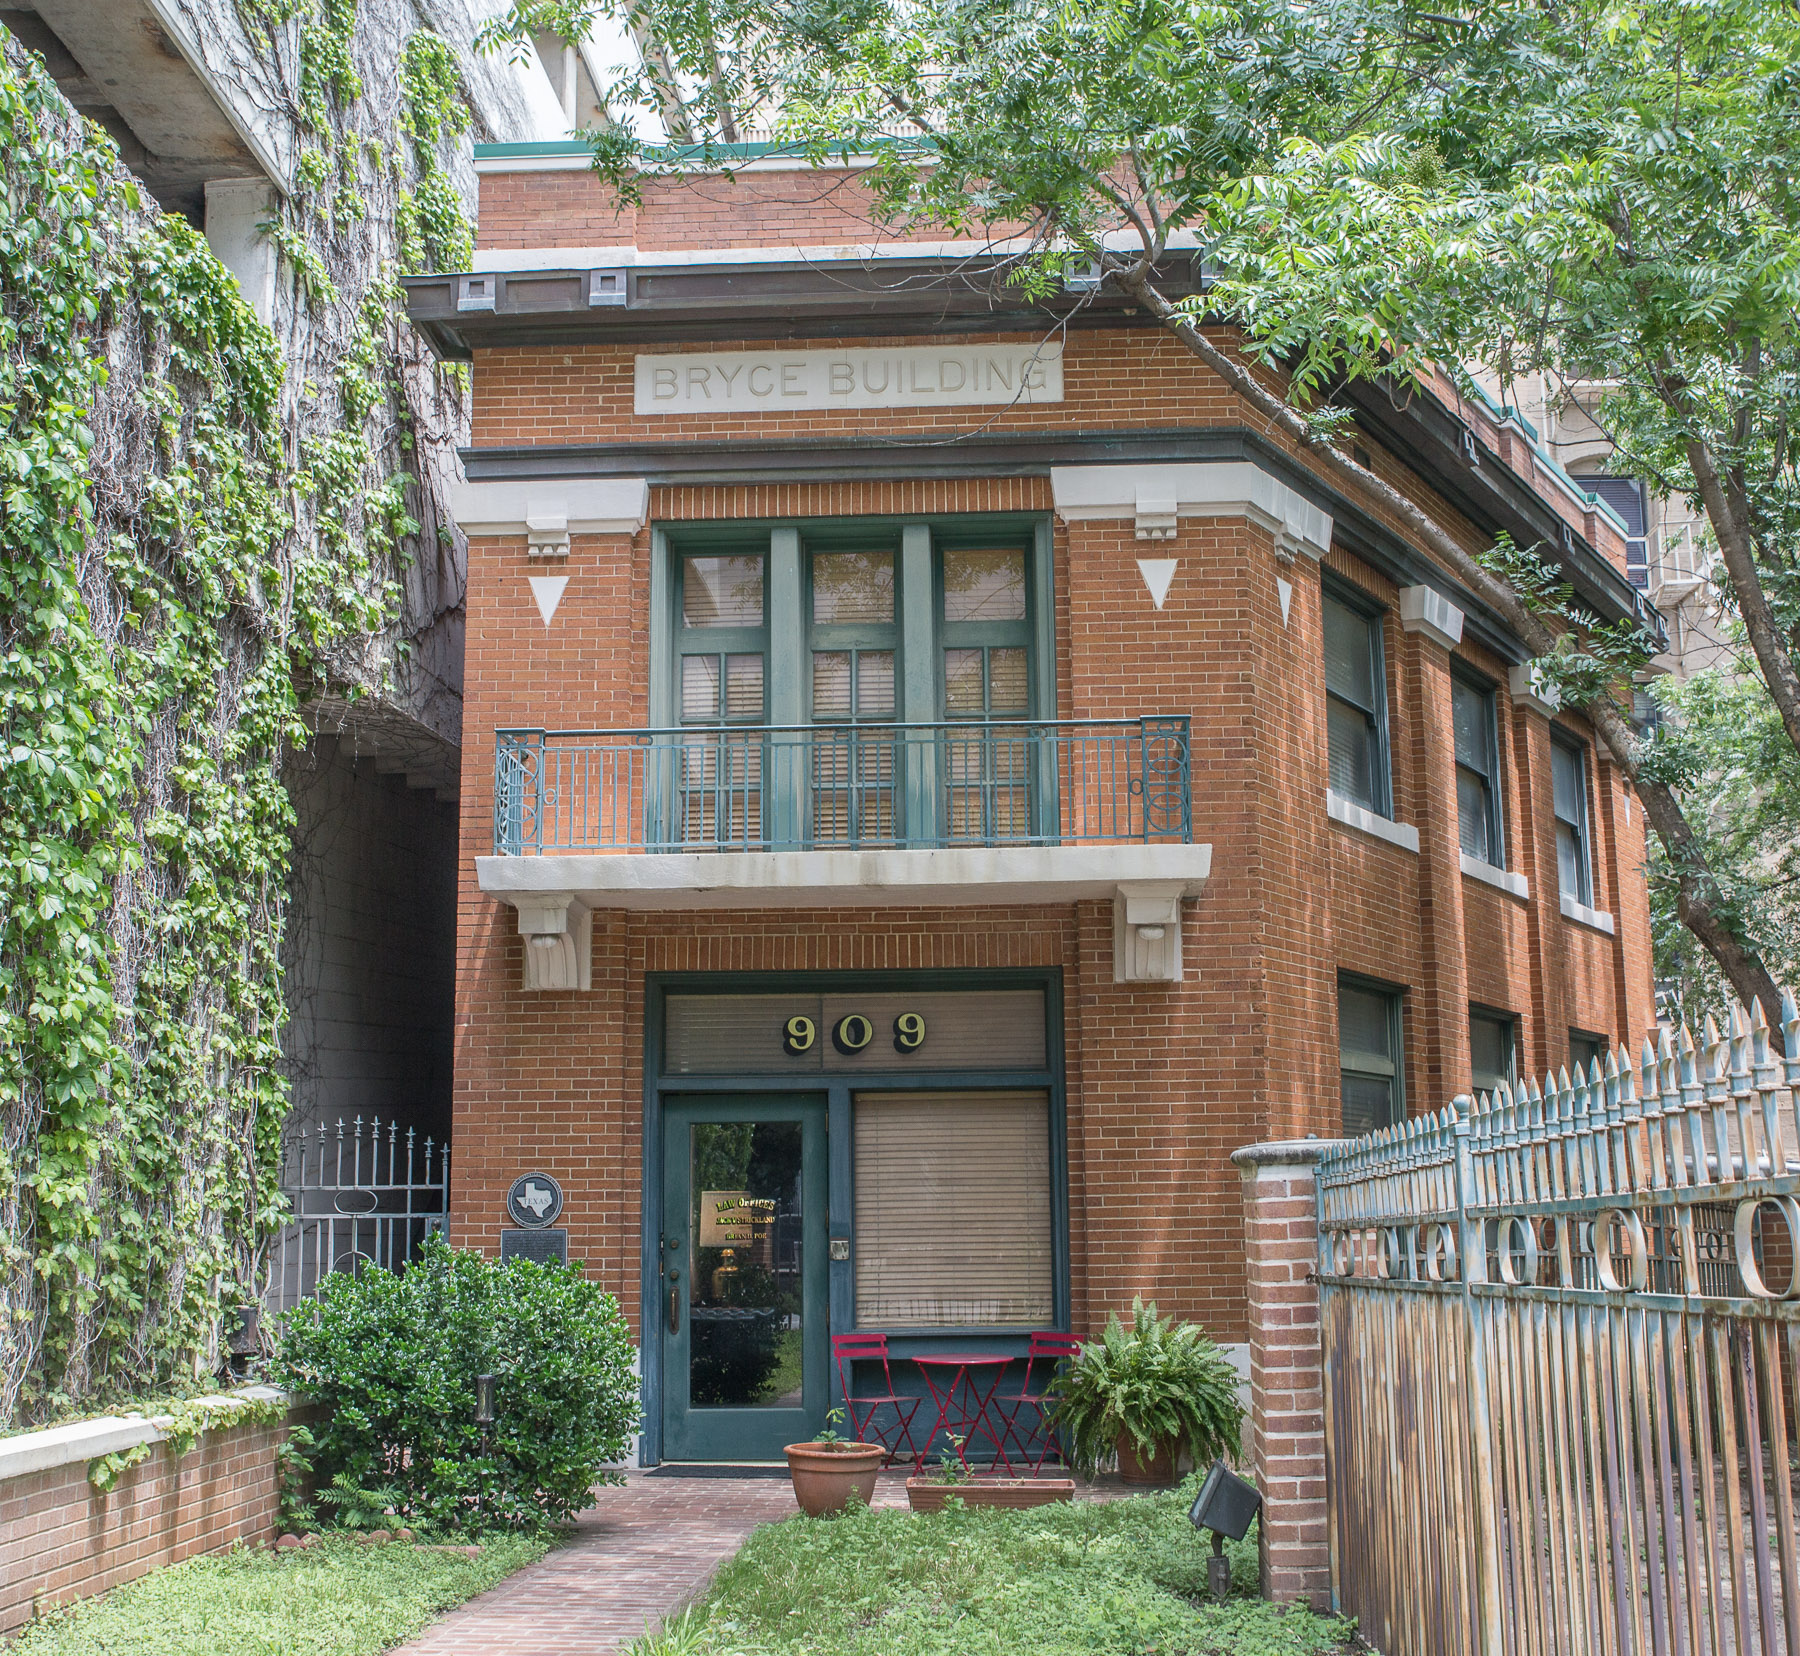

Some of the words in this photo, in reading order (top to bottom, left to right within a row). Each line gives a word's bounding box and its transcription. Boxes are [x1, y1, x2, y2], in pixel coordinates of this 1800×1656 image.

[652, 361, 808, 400] BRYCE
[828, 357, 1048, 395] BUILDING
[783, 1012, 927, 1057] 909
[523, 1197, 550, 1205] TEXAS
[716, 1199, 737, 1212] LAW
[738, 1197, 777, 1211] OFFICES
[737, 1216, 776, 1225] STRICKLAND
